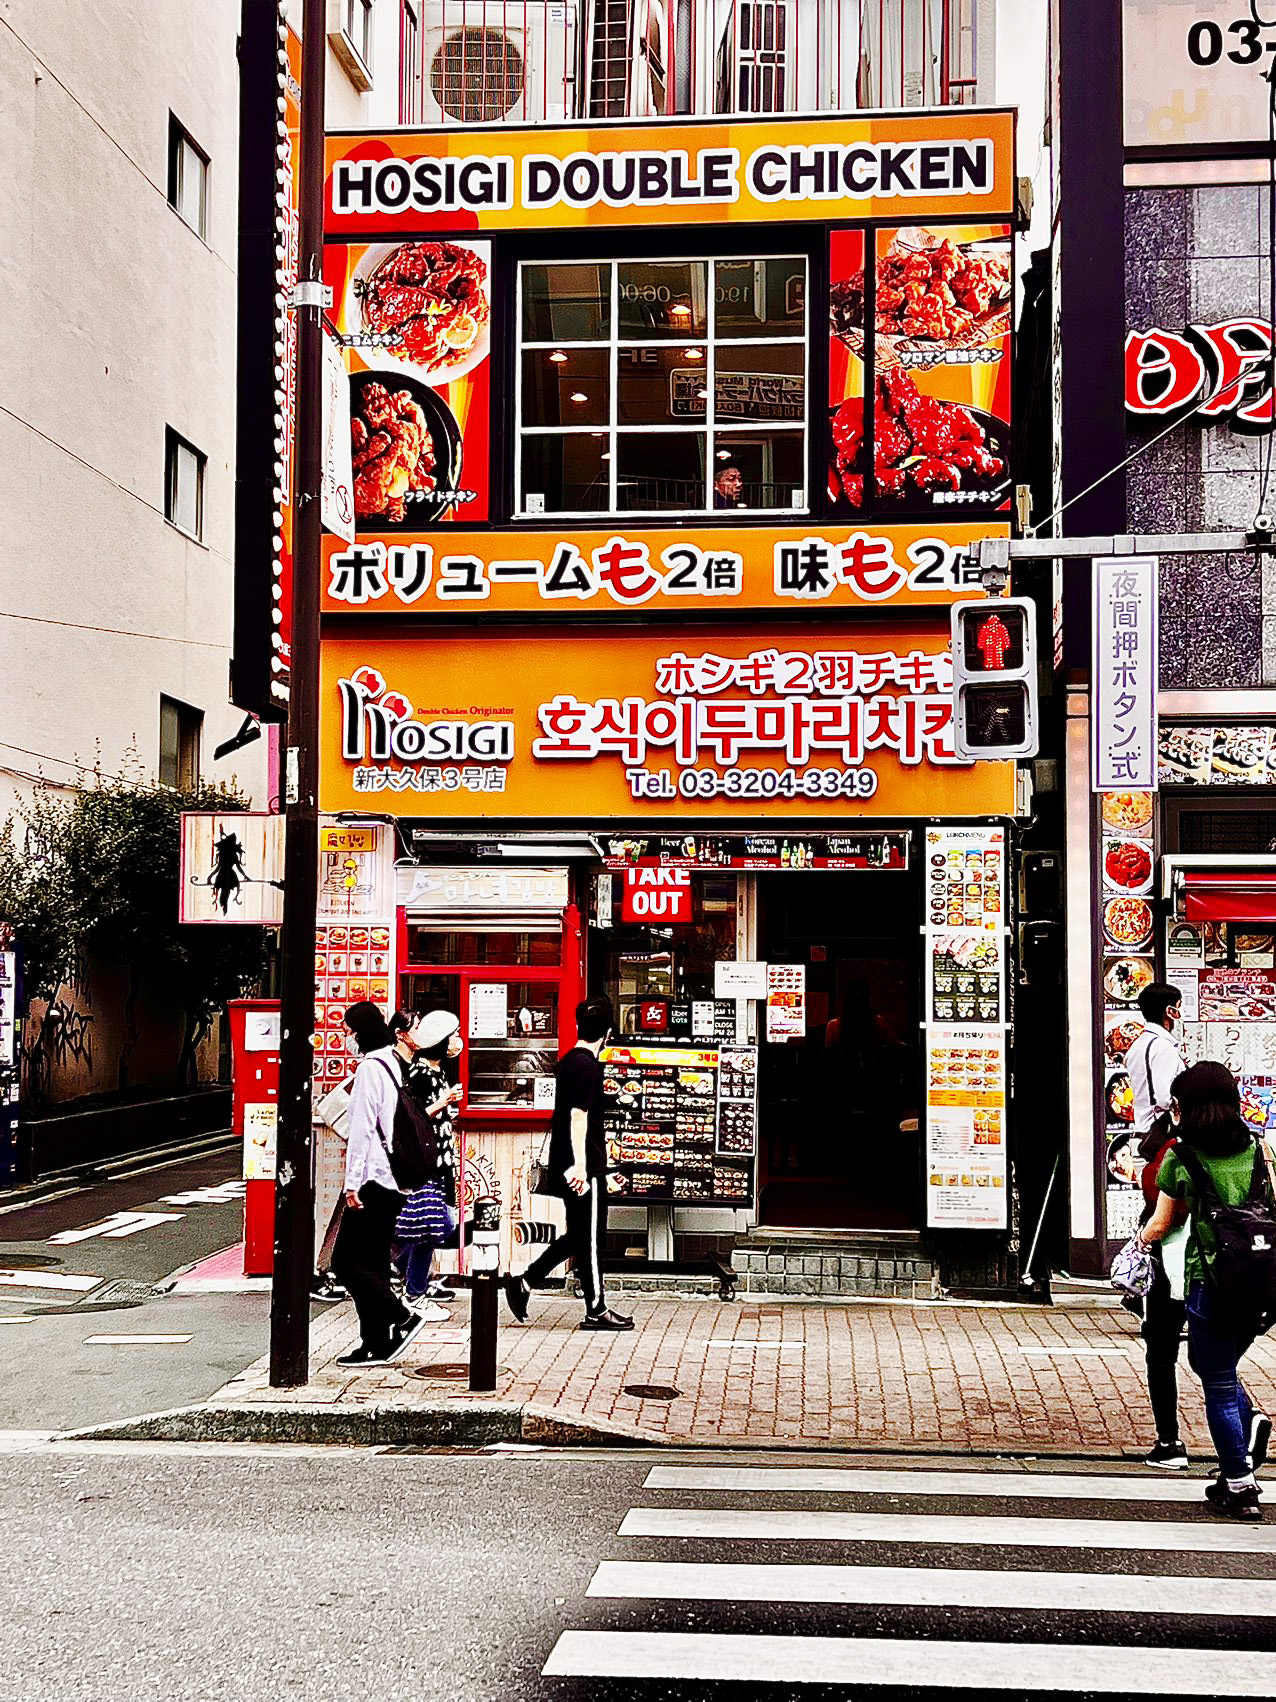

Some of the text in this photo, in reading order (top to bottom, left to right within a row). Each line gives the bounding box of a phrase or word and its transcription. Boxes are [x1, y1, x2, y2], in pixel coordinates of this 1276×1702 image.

[338, 145, 988, 209] HOSIGI DOUBLE CHICKEN
[405, 490, 478, 503] フライドチキン
[335, 540, 983, 598] ボリュームも2倍 味も2倍
[1111, 569, 1140, 780] 夜間押ボタン式
[417, 705, 515, 717] Double Chicken Originator
[355, 767, 505, 790] 新大久保3号店
[630, 768, 875, 796] Tel. 03-3204-3349
[660, 837, 681, 847] Beer
[826, 836, 852, 846] Japan
[628, 867, 691, 886] TAKE
[632, 890, 684, 915] OUT
